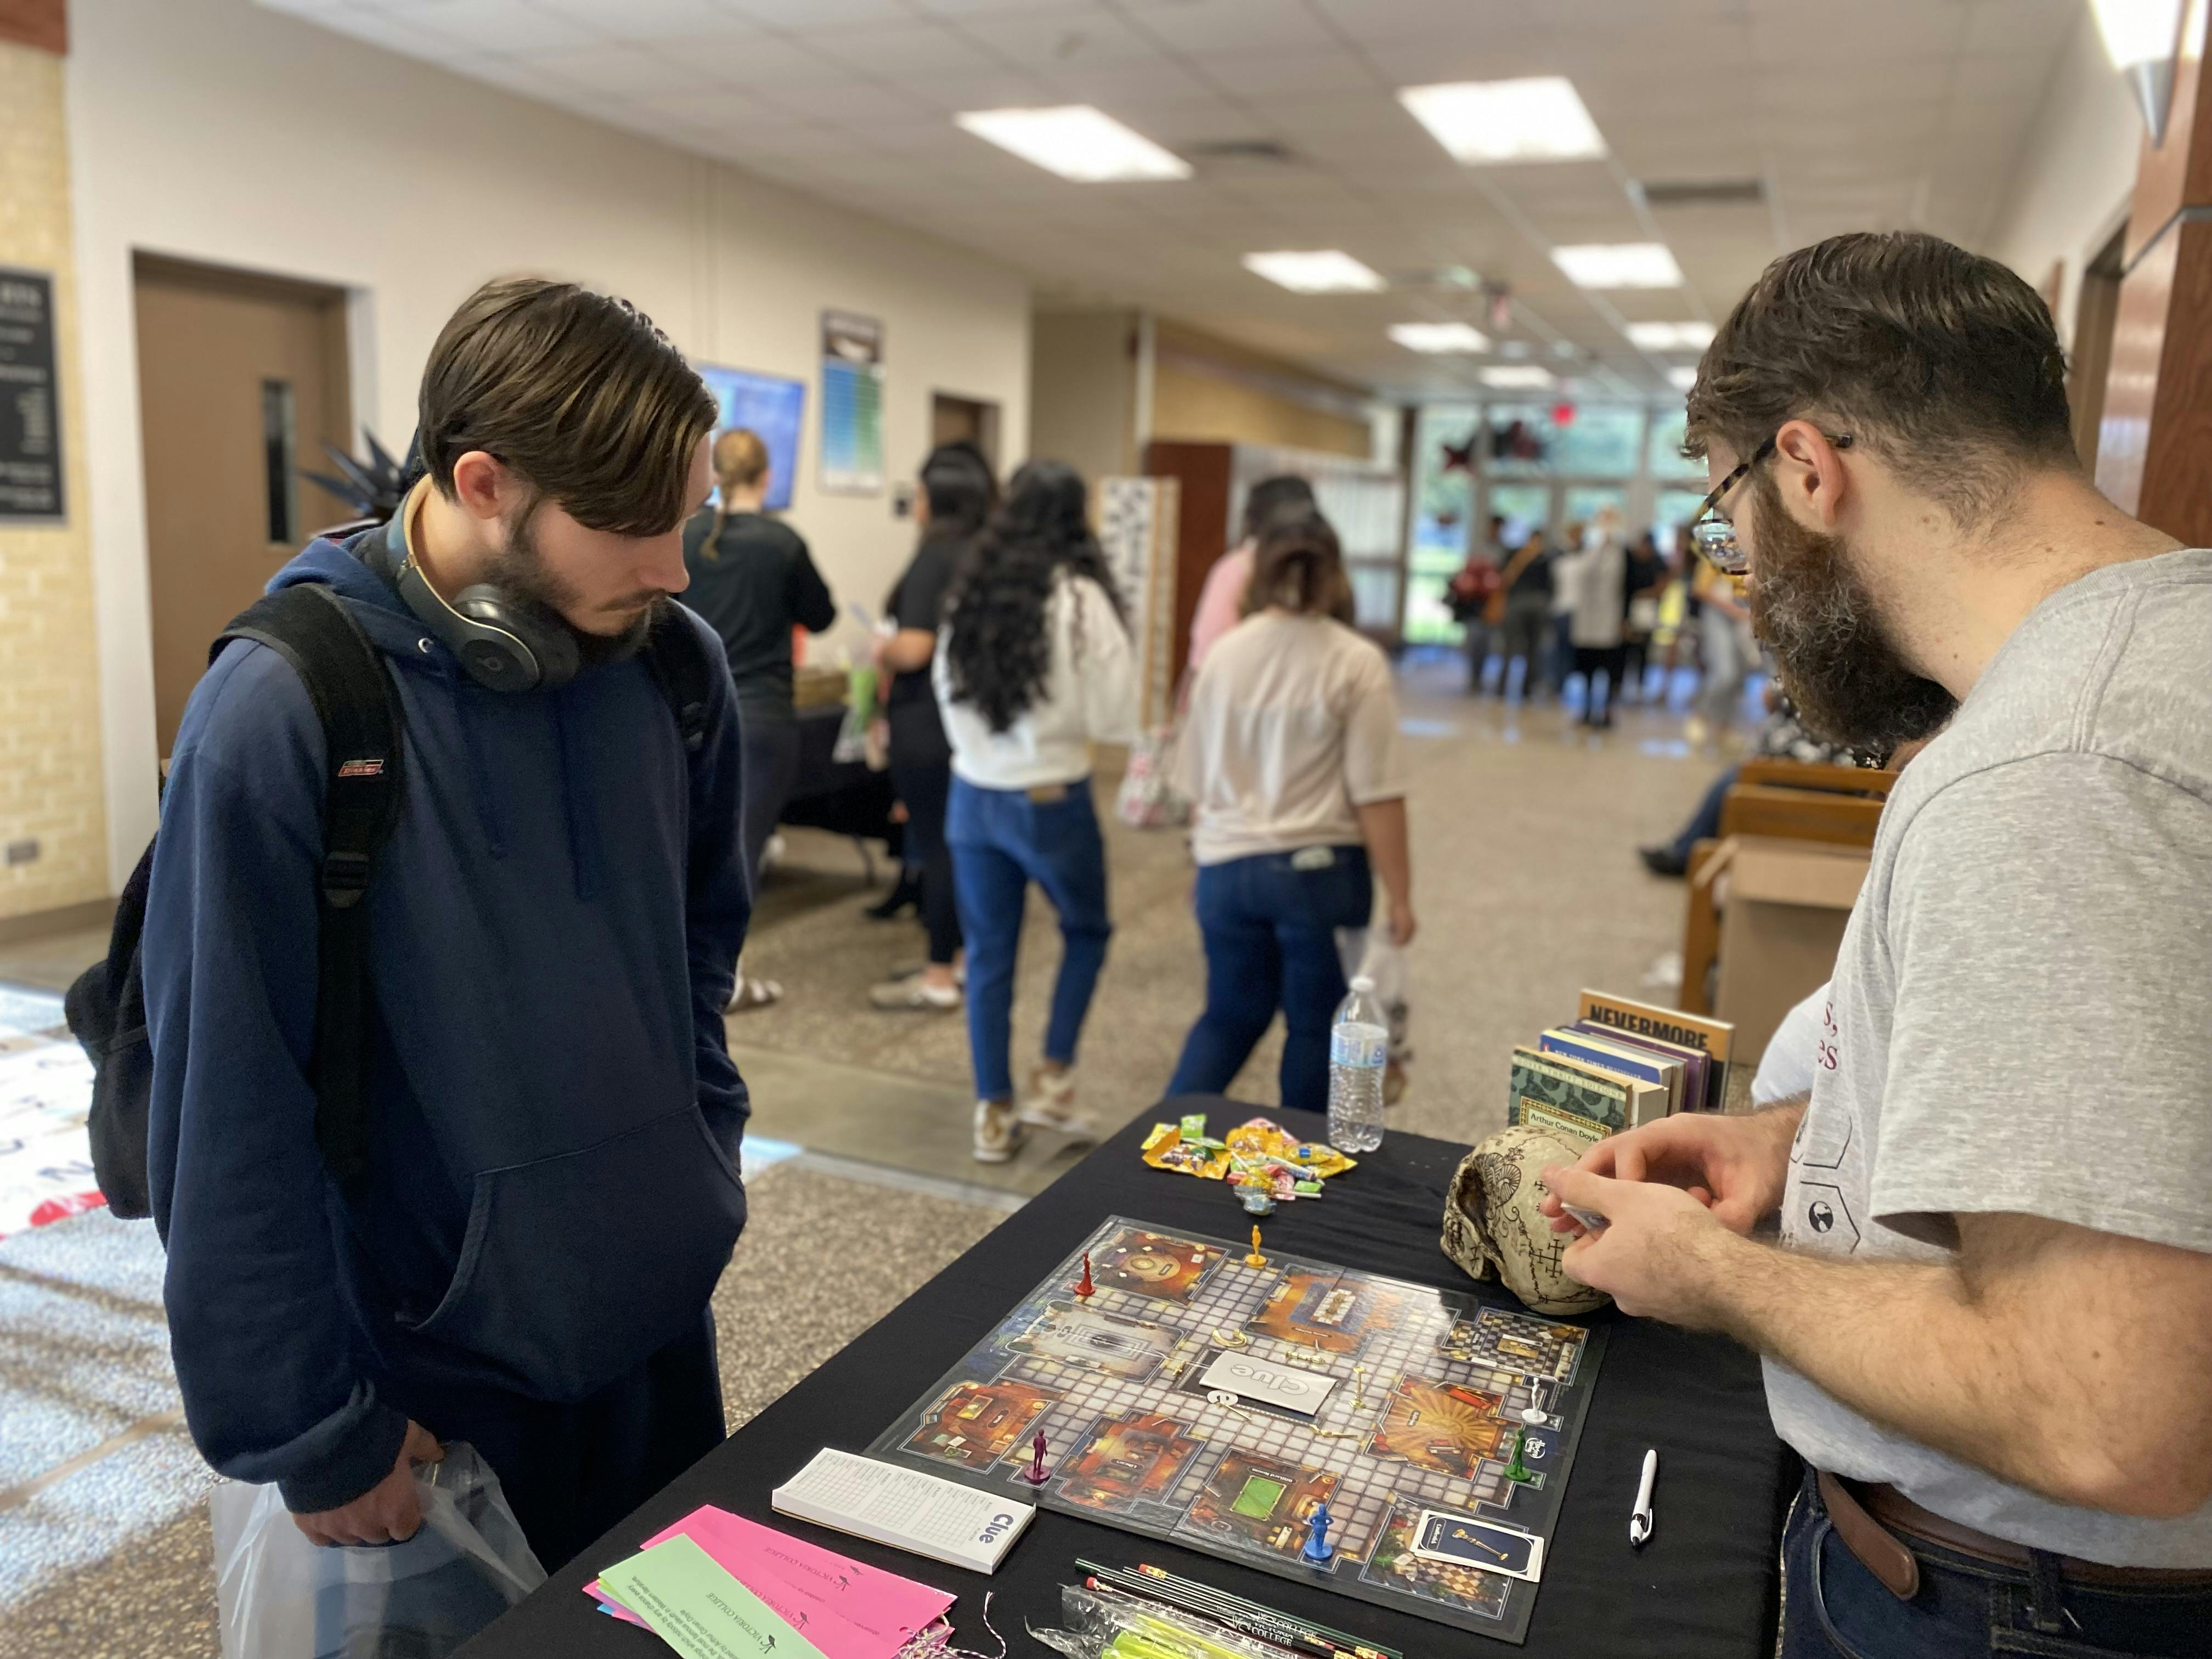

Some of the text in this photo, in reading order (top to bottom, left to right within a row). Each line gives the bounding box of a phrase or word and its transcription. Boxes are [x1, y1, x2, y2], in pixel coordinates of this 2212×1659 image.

[1590, 1004, 1708, 1048] NEVERMORE
[1569, 1053, 1584, 1063] YORK
[1587, 1059, 1605, 1069] TIMES
[1531, 1113, 1599, 1142] Arthur Conan Doyle
[1230, 1362, 1310, 1396] Clue
[979, 1514, 1014, 1543] Clue
[764, 1547, 797, 1564] COLLEGE
[799, 1563, 832, 1581] VICTORIA
[648, 1592, 665, 1609] Western
[707, 1591, 734, 1617] COLLEGE
[762, 1595, 793, 1617] VICTORIA
[679, 1608, 693, 1622] Doyle
[667, 1622, 682, 1637] nobody
[692, 1620, 707, 1634] Conan
[733, 1615, 761, 1641] VICTORIA
[1251, 1626, 1293, 1646] COLLEGE
[706, 1632, 720, 1646] Arthur
